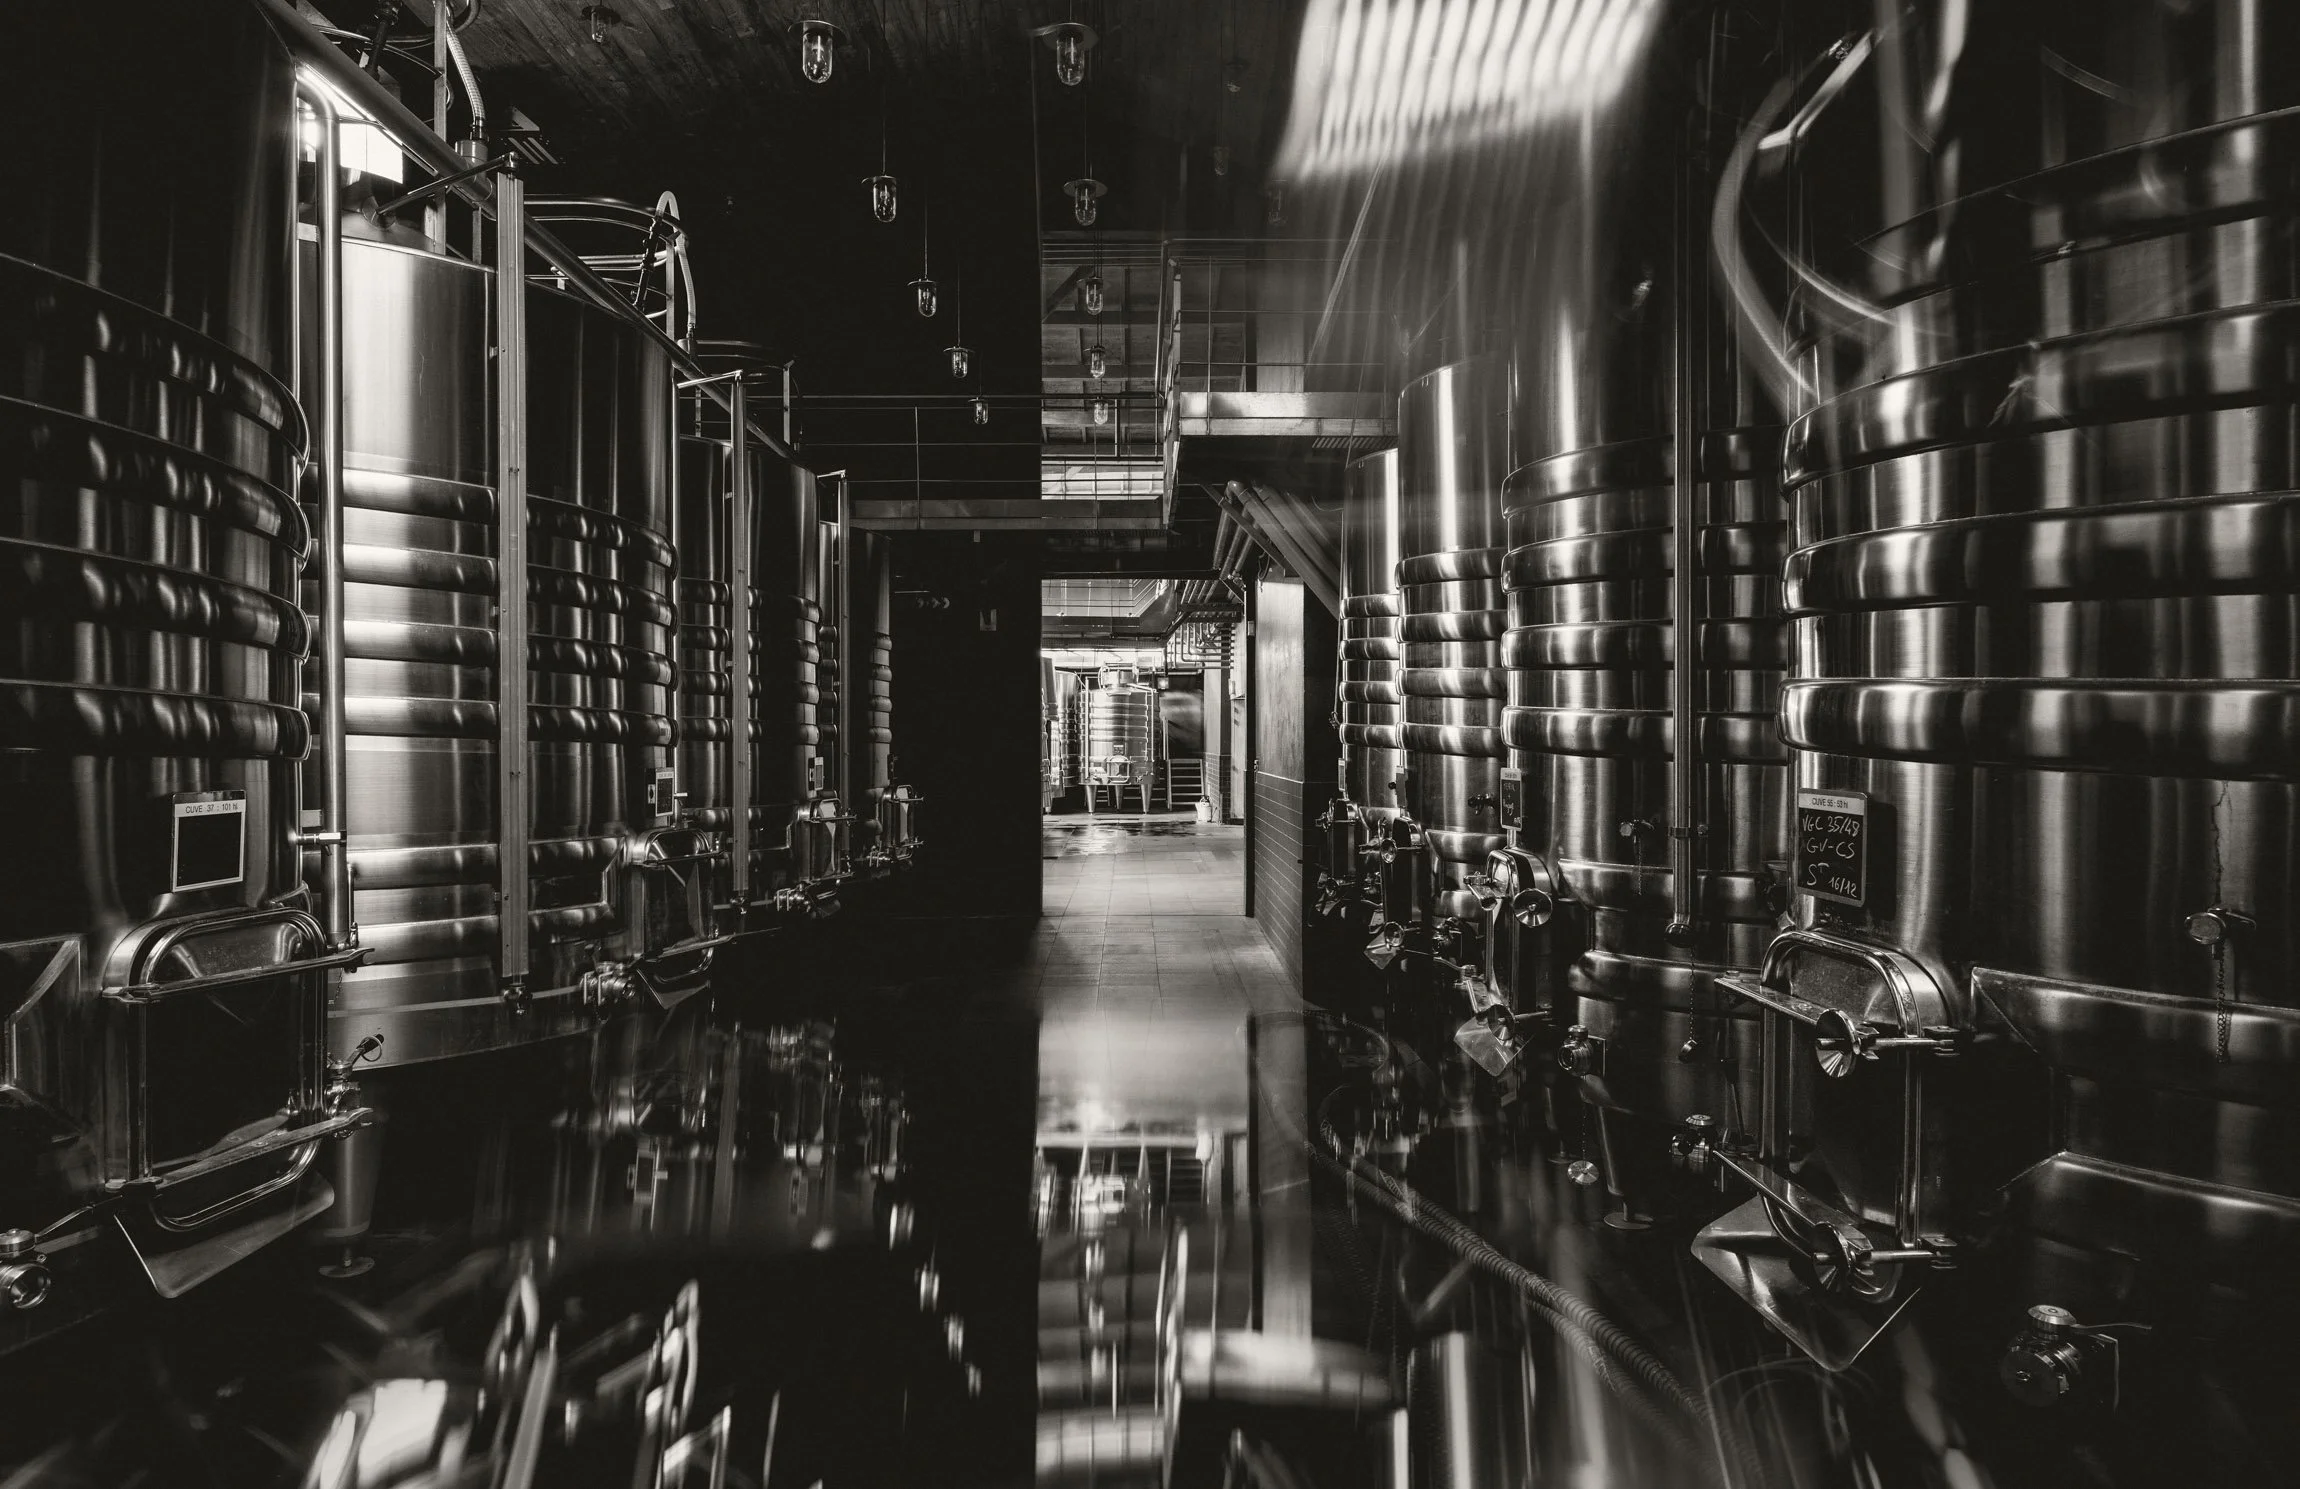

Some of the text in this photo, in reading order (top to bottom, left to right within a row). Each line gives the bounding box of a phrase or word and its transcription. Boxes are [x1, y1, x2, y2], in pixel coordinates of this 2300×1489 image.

[1812, 798, 1826, 806] CUVE
[185, 805, 203, 813] CUVE
[207, 804, 214, 812] 37
[222, 803, 231, 811] 101
[1828, 876, 1858, 898] 16/12
